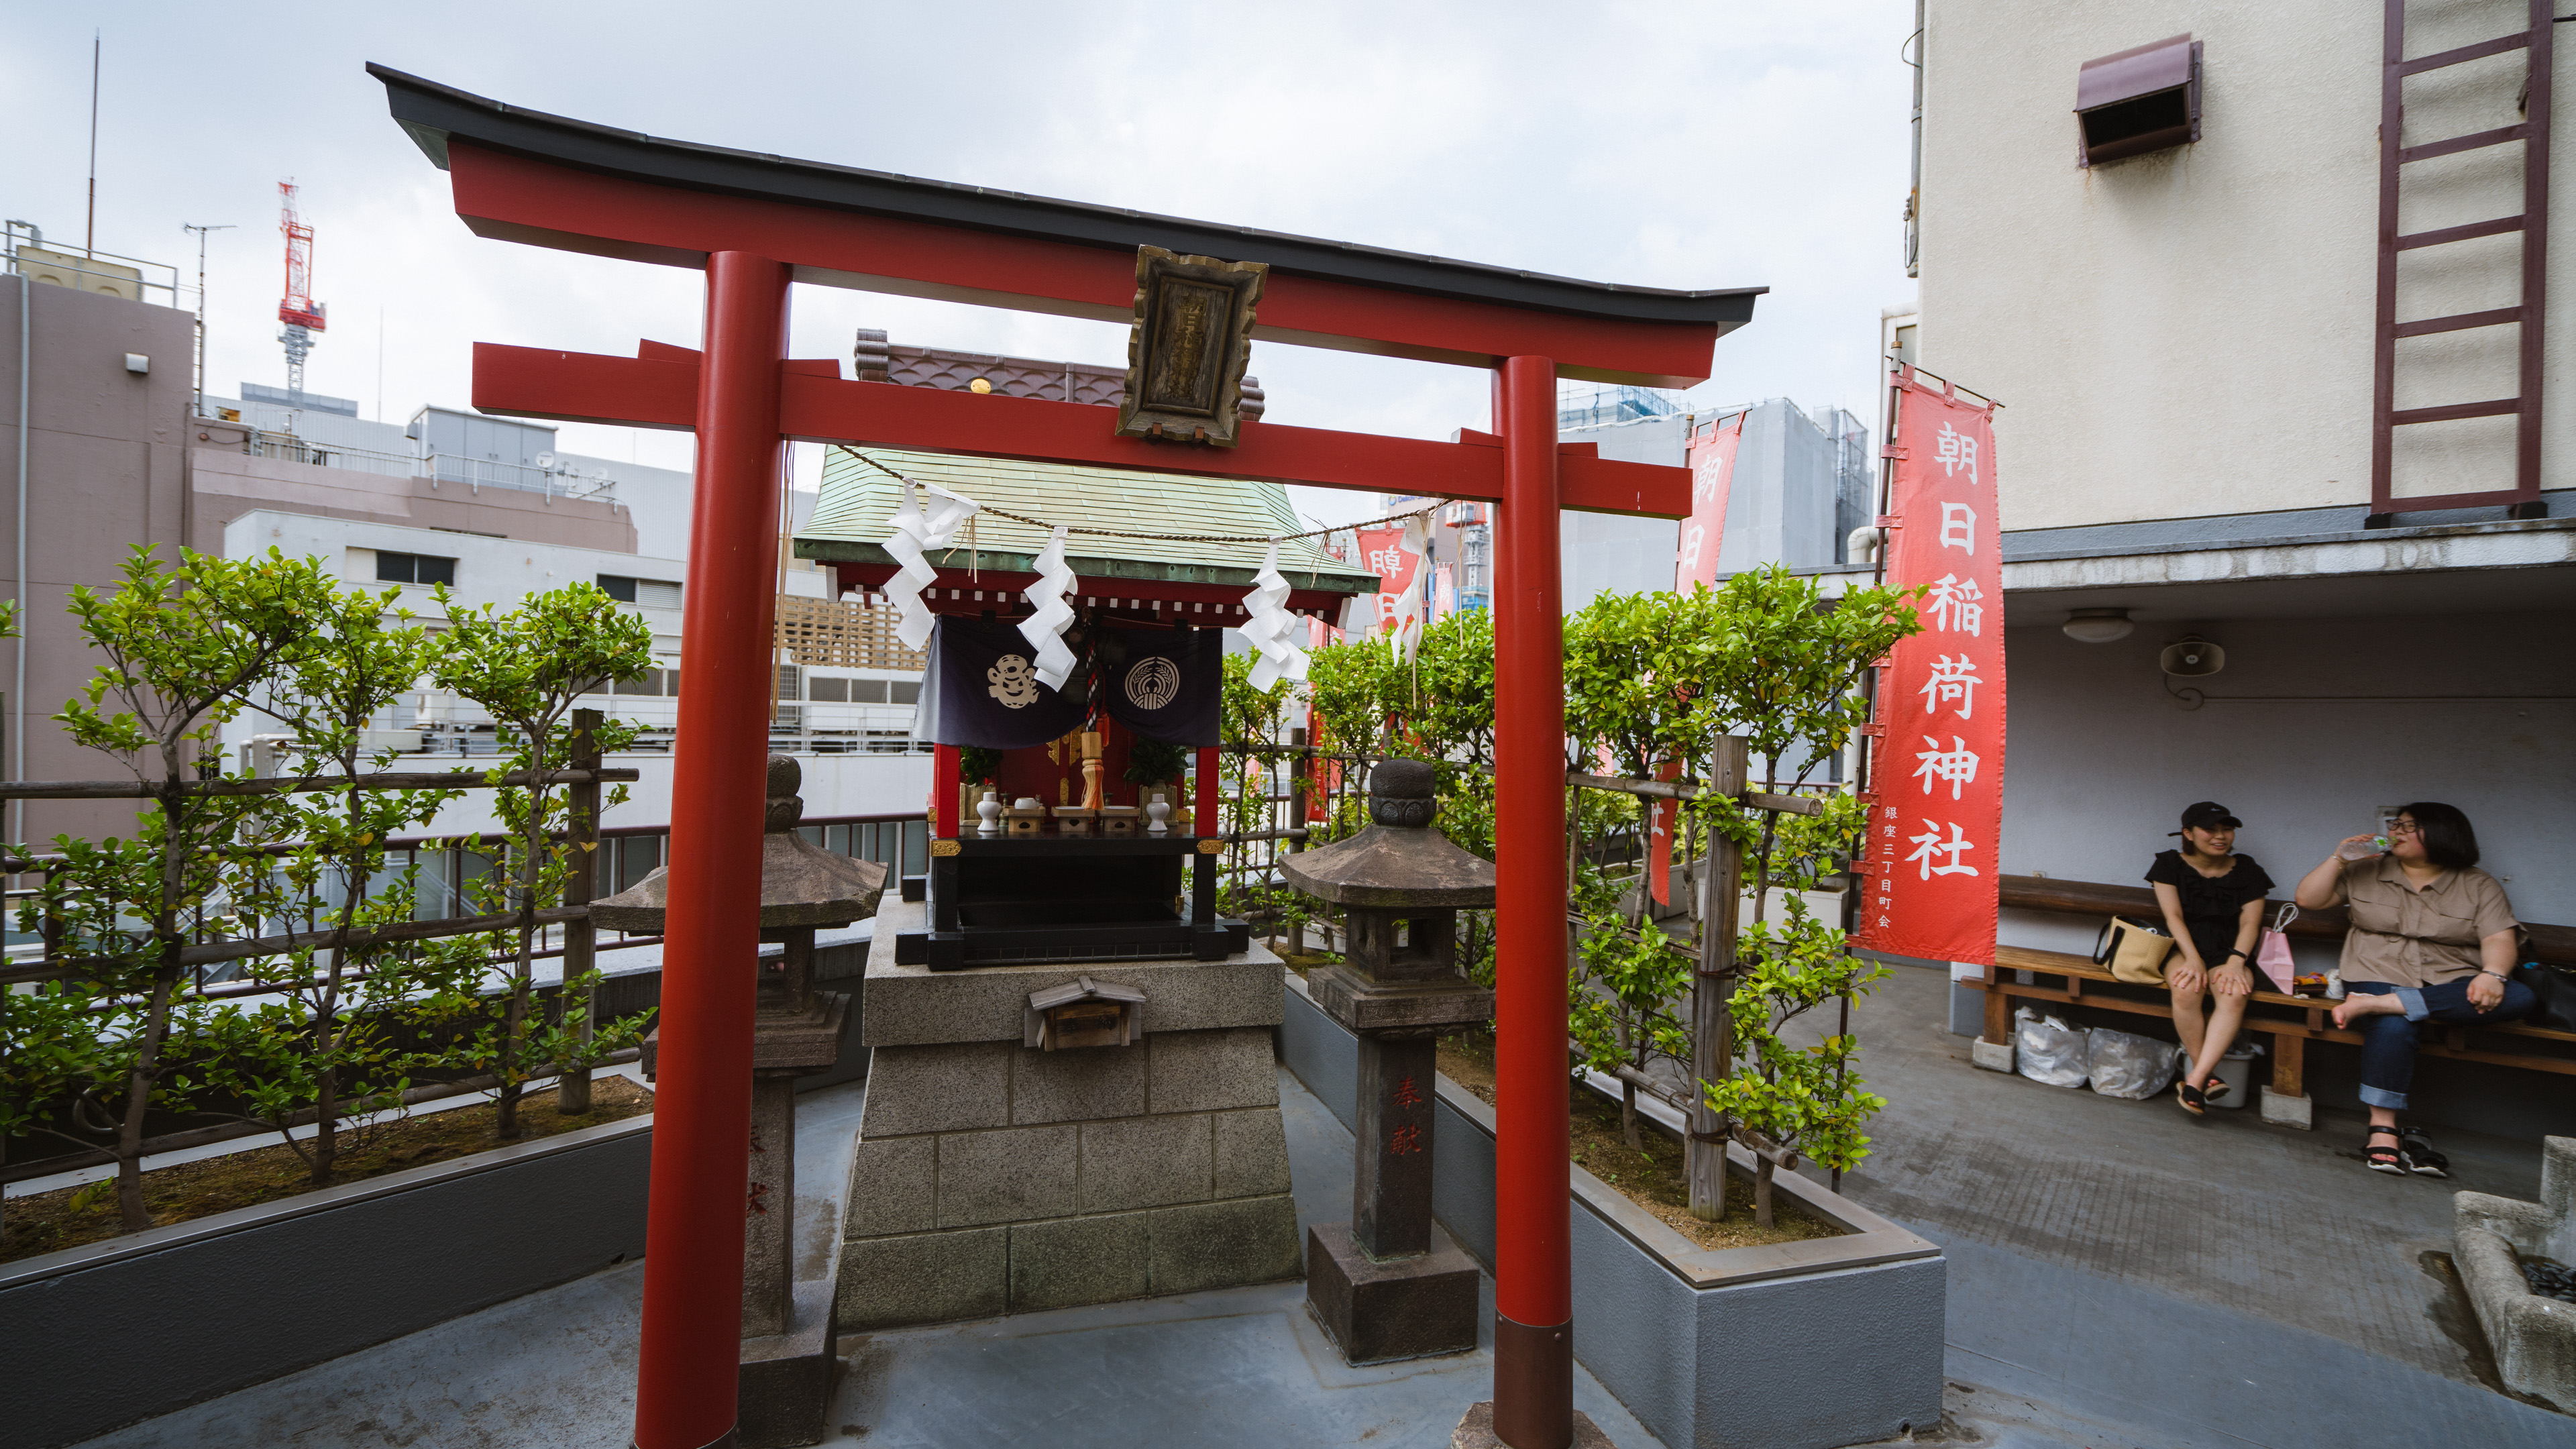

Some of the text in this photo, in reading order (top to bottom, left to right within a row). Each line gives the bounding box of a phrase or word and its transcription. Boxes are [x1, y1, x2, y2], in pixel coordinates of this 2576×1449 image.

[1904, 421, 1984, 881] 朝日稲荷神社
[1878, 806, 1898, 928] 銀座三丁目町会
[1391, 1075, 1422, 1155] 奉献
